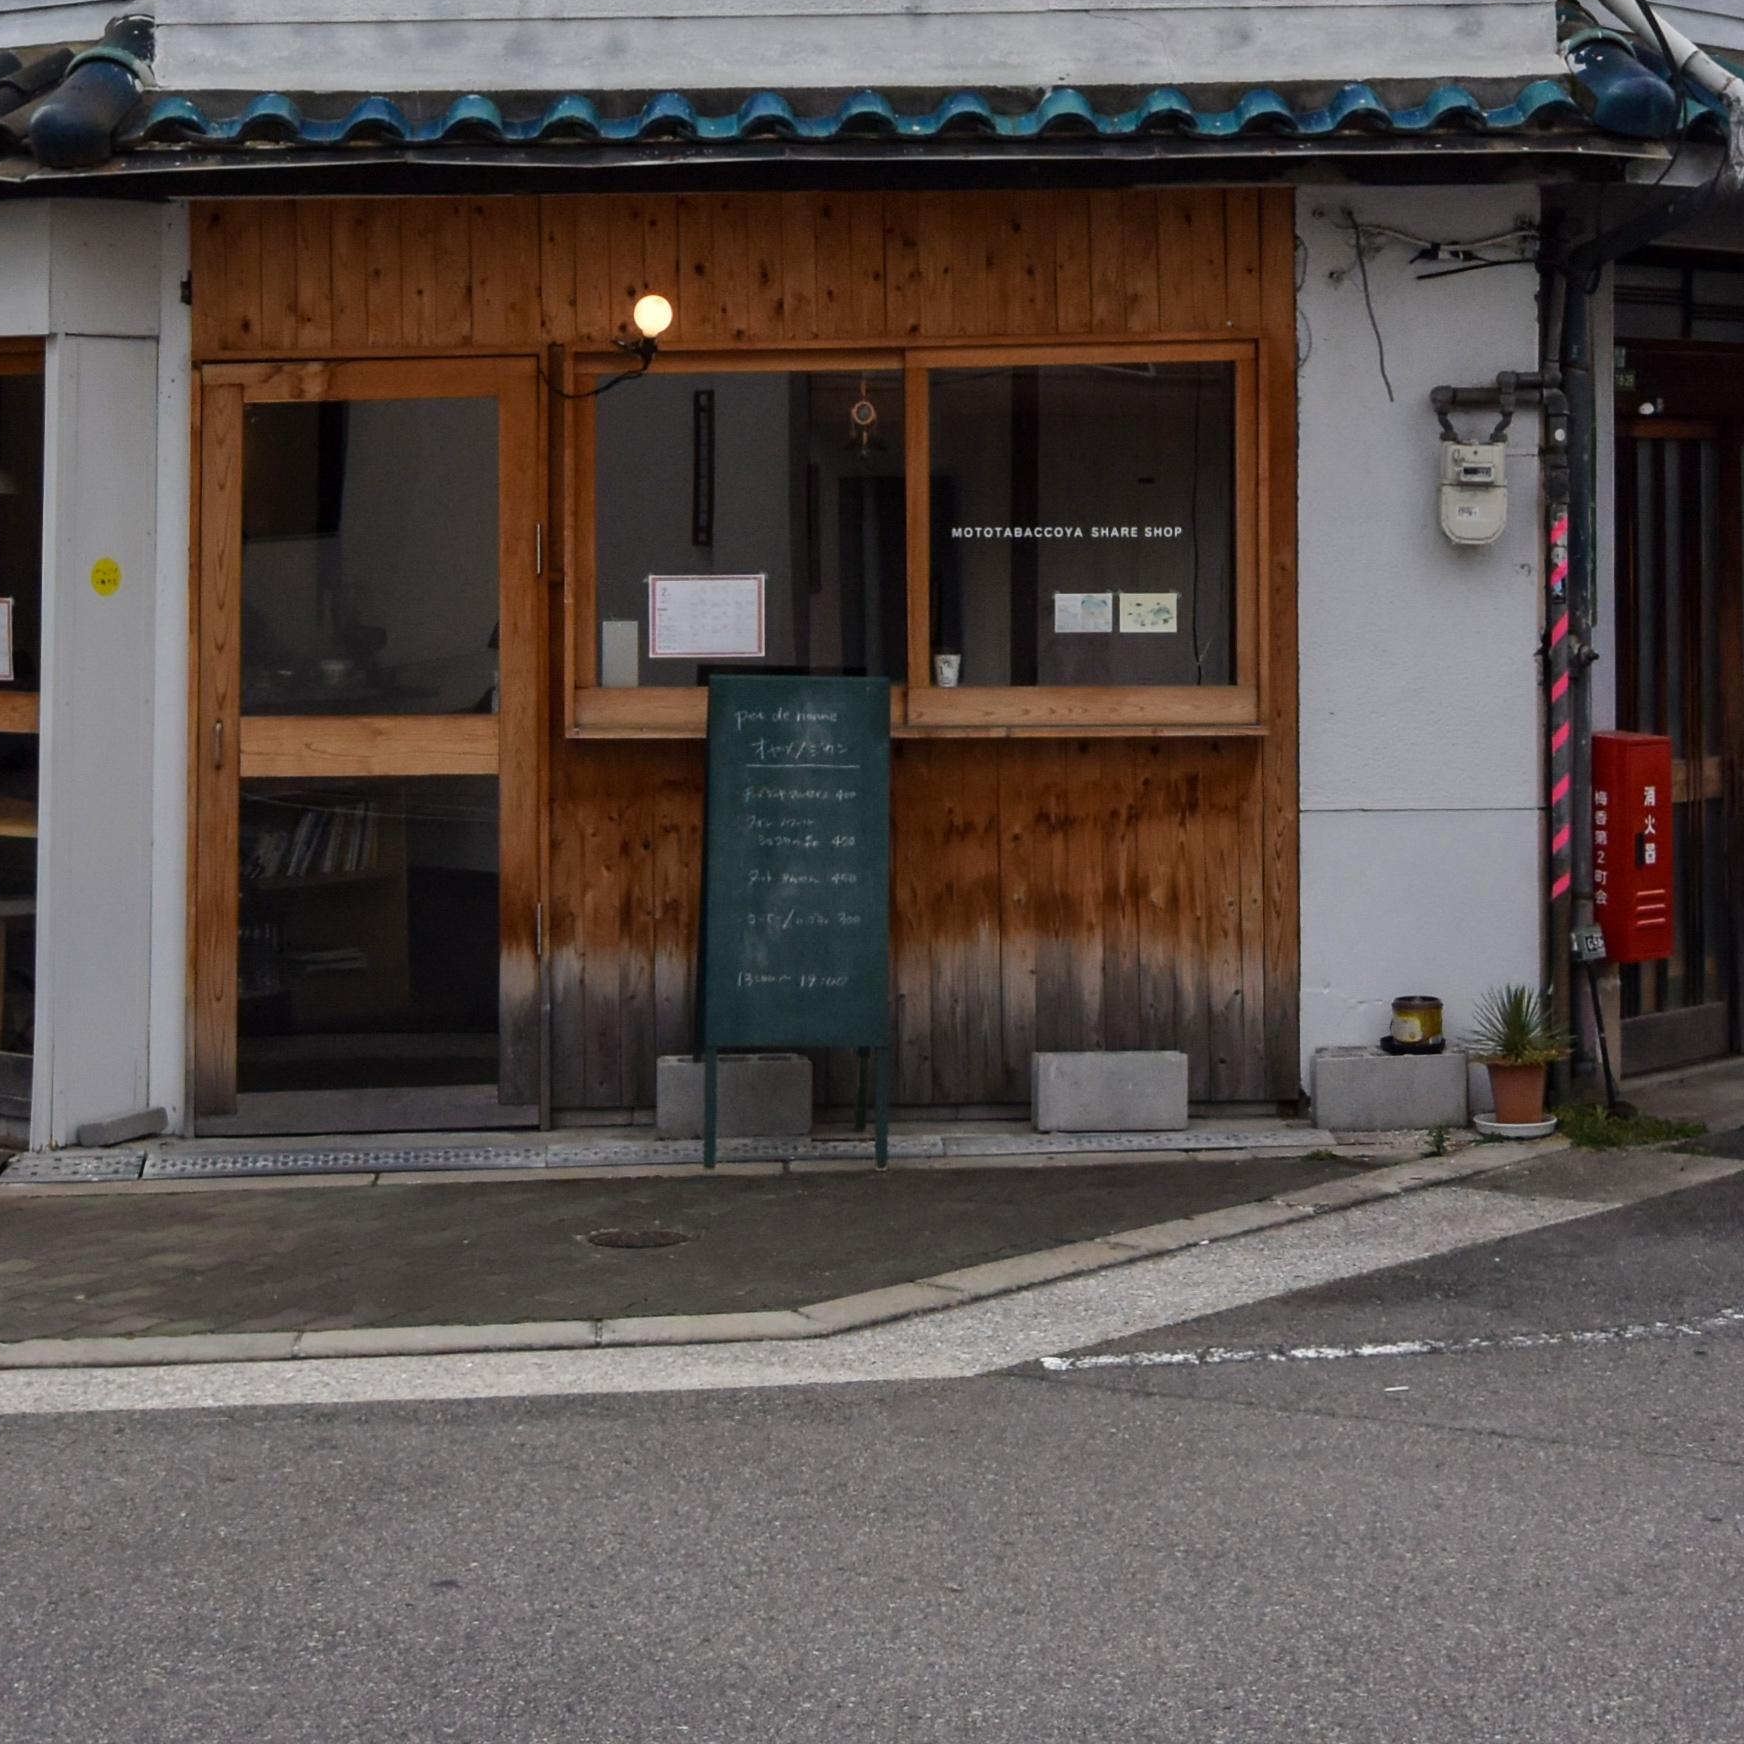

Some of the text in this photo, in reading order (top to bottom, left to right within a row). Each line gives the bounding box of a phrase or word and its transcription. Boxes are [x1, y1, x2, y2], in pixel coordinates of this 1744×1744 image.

[951, 526, 1183, 538] MOTOTABACCOYA SHARE SHOP
[1594, 790, 1609, 905] 梅香第2町会
[1643, 786, 1657, 864] 消火器
